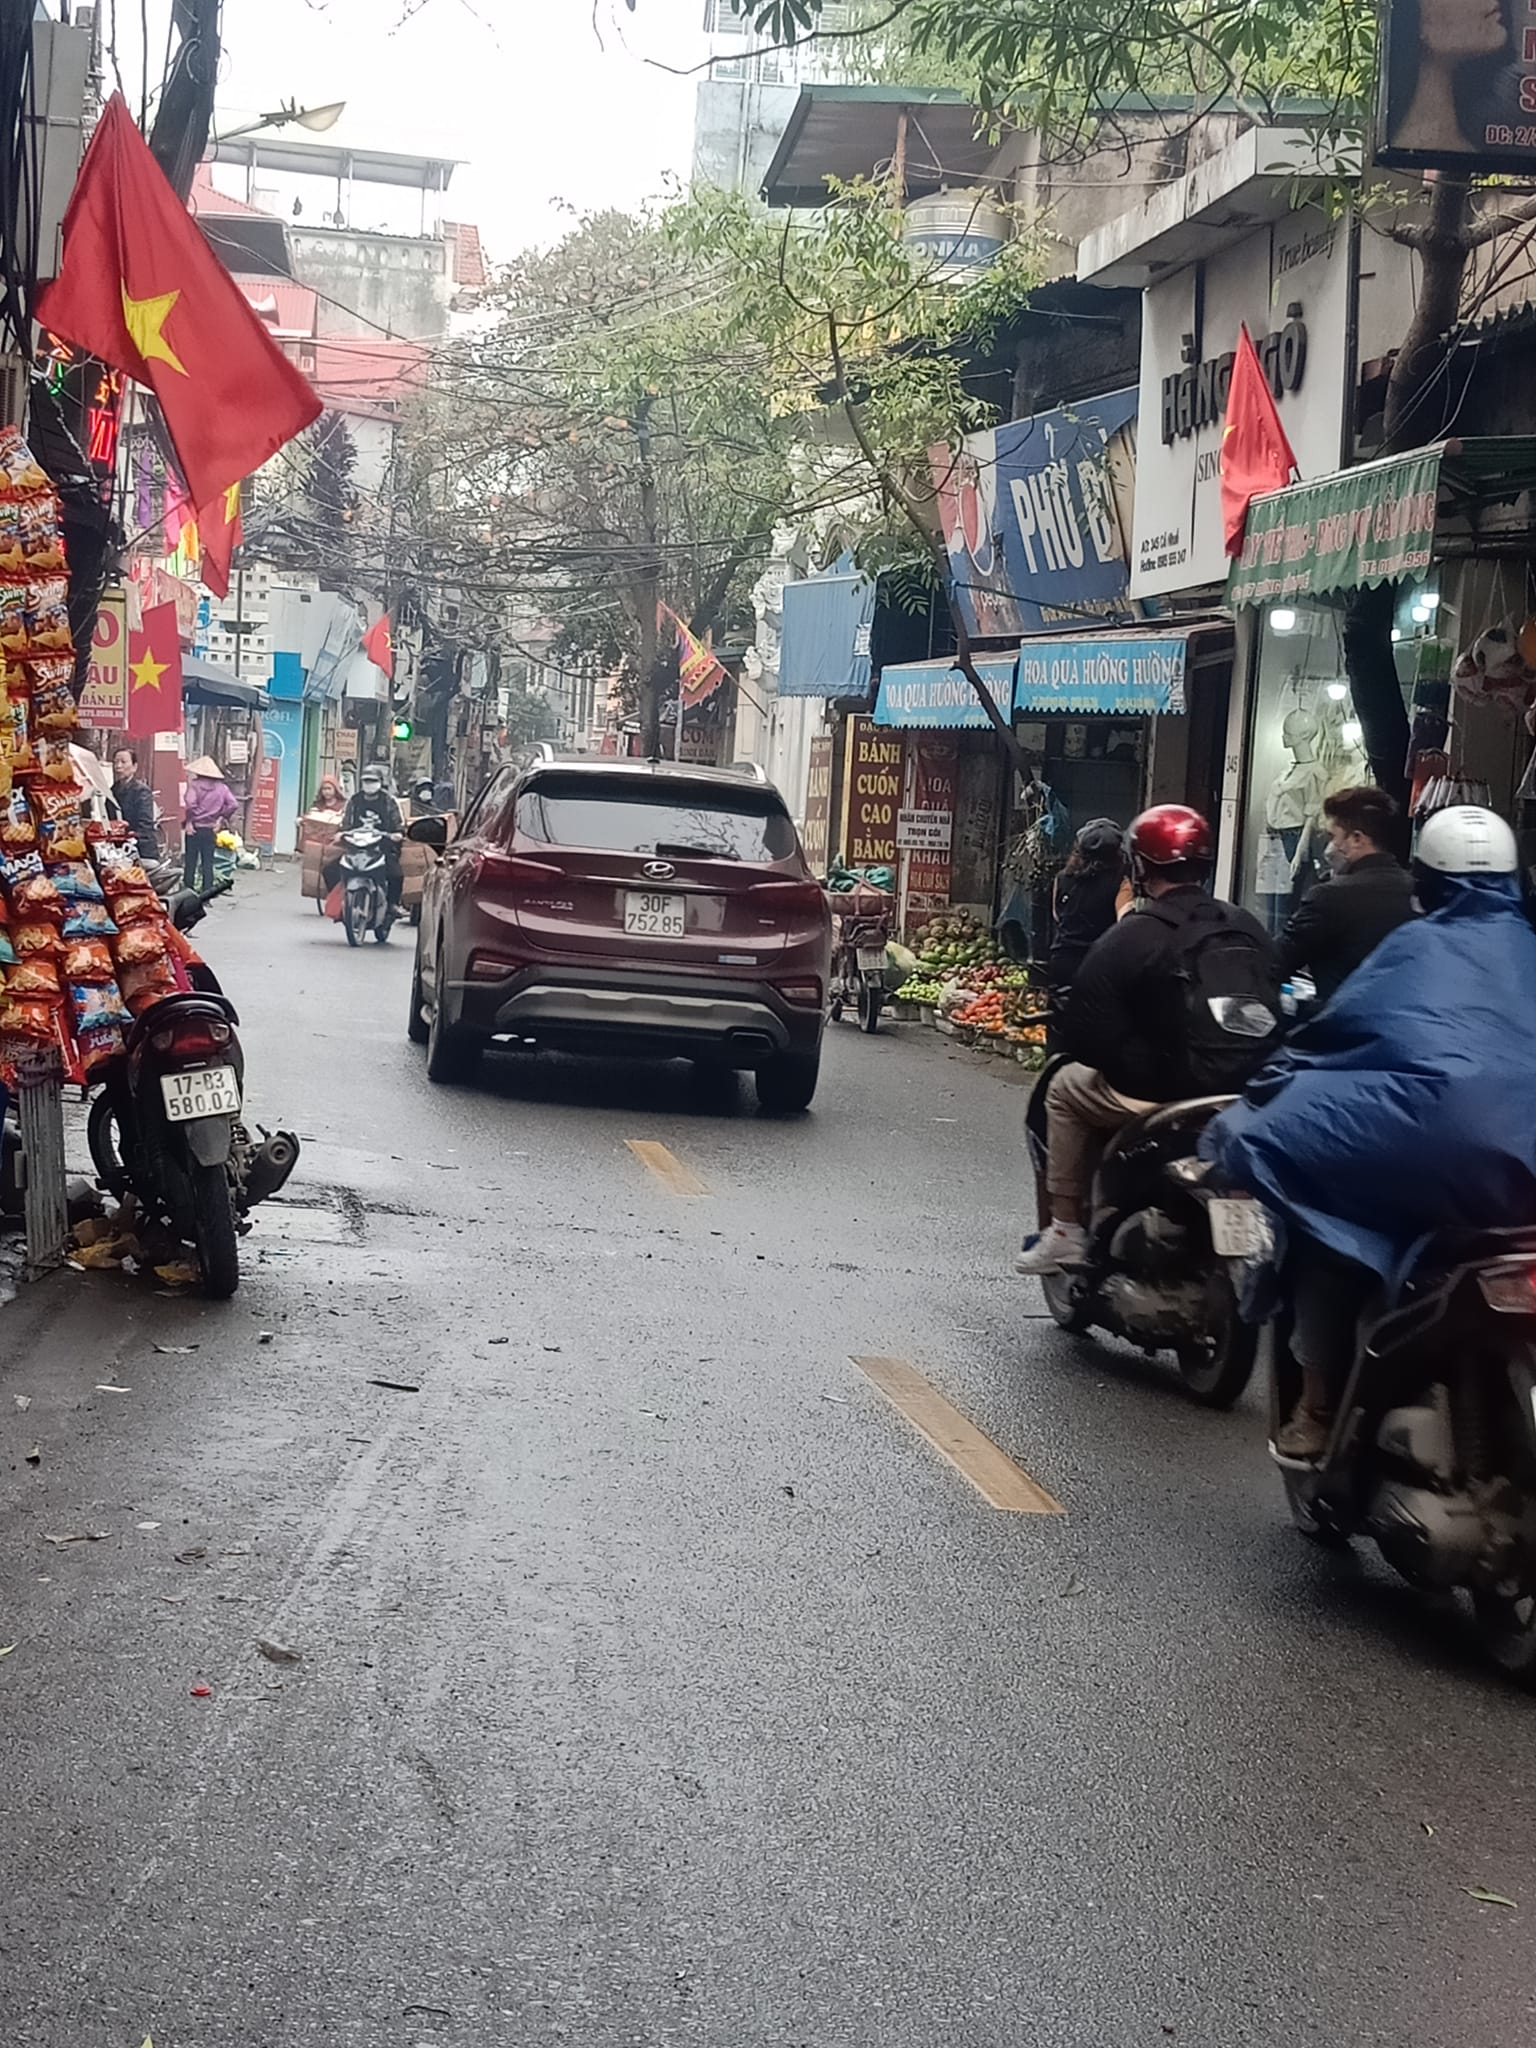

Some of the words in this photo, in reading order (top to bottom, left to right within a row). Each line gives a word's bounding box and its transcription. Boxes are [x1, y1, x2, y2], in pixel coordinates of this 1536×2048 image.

[1024, 659, 1047, 685] HOA
[1051, 648, 1079, 690] QUẢ
[858, 737, 901, 764] BÁNH
[857, 766, 899, 796] CUỐN
[861, 803, 892, 825] CAO
[853, 827, 895, 861] BẰNG
[640, 894, 673, 914] 30F
[627, 913, 683, 934] 752.85
[173, 1070, 225, 1095] 17-B3
[168, 1090, 236, 1117] 580.02
